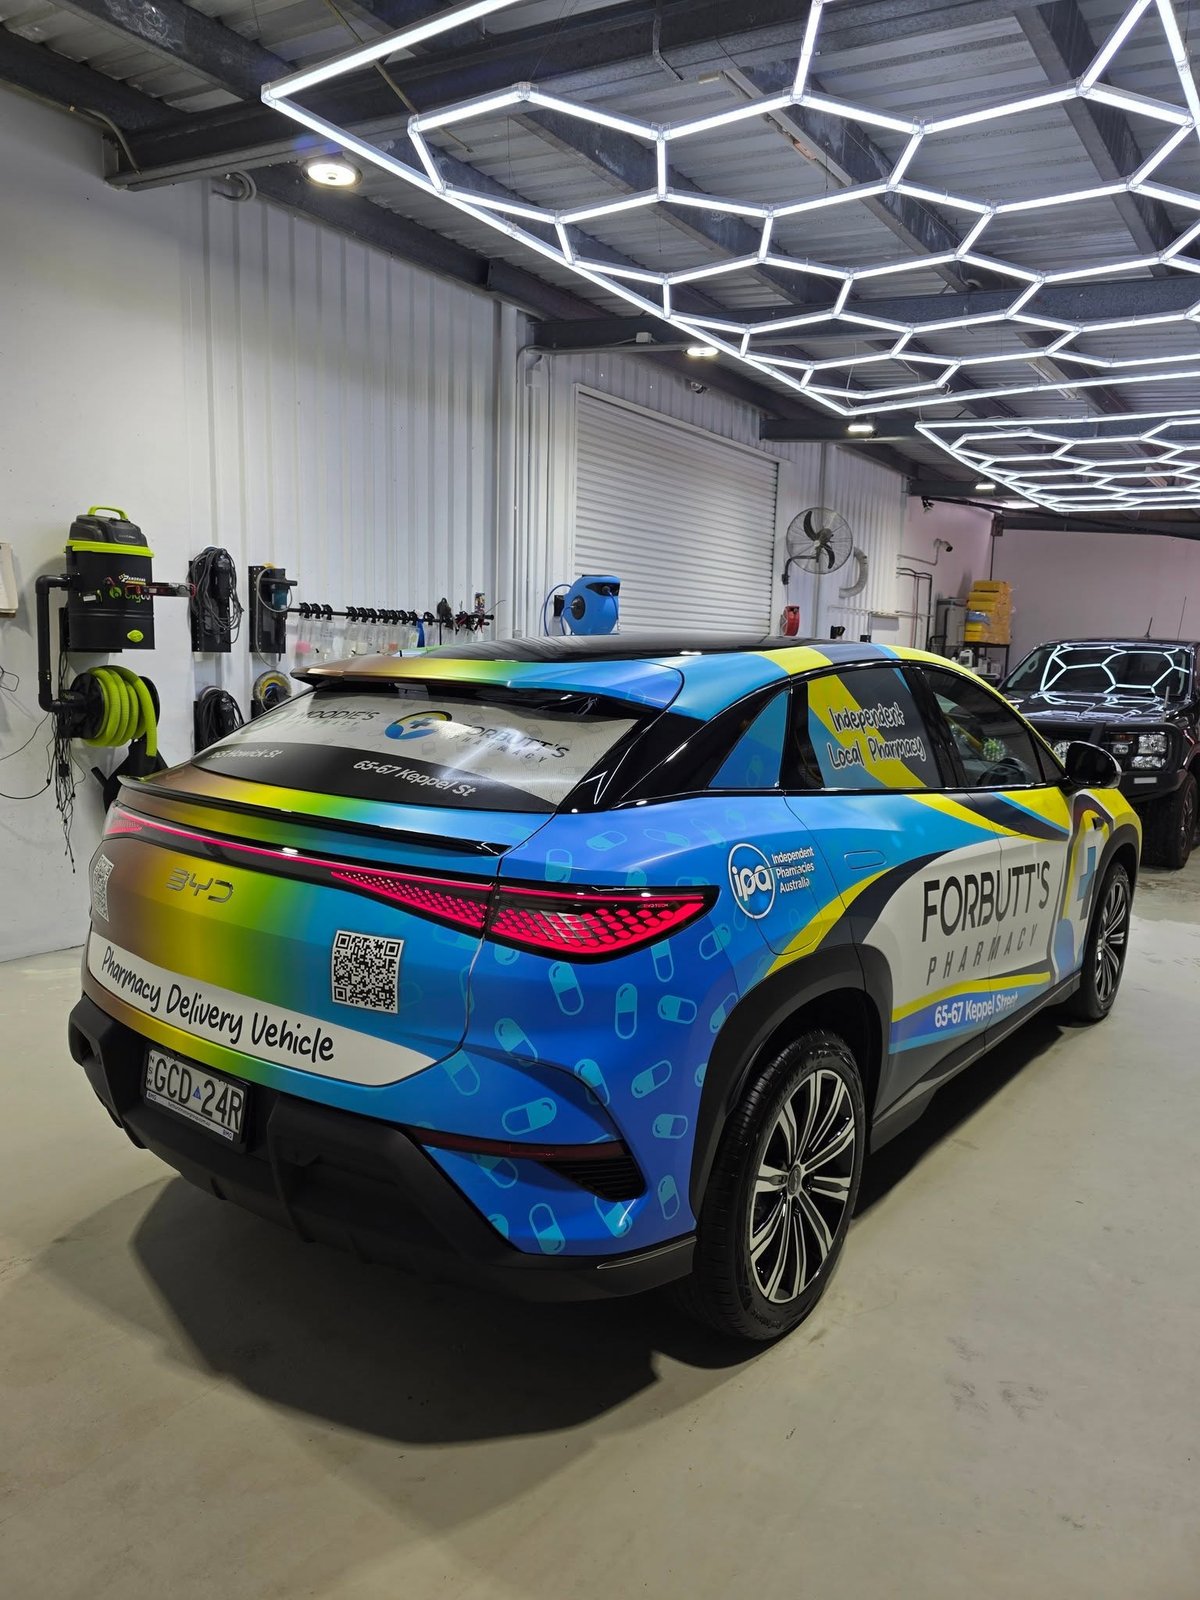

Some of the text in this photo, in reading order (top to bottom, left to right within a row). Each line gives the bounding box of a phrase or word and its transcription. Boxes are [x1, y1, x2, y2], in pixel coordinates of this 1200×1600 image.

[829, 702, 905, 734] Independent
[827, 736, 926, 769] Local Pharmacy
[353, 760, 477, 797] 65-67 Keppel St
[772, 846, 815, 864] Independent
[776, 860, 815, 880] Pharmacies
[166, 867, 234, 903] BYD
[731, 865, 773, 902] ipa
[780, 877, 810, 894] Australia
[922, 860, 1051, 942] FORBUTT'S
[926, 923, 1038, 986] PHARMACY
[101, 946, 335, 1063] Pharmacy Delivery Vehicle
[934, 991, 1019, 1028] 65-67 Keppel Street
[154, 1058, 192, 1104] GCD
[200, 1079, 242, 1130] 24R
